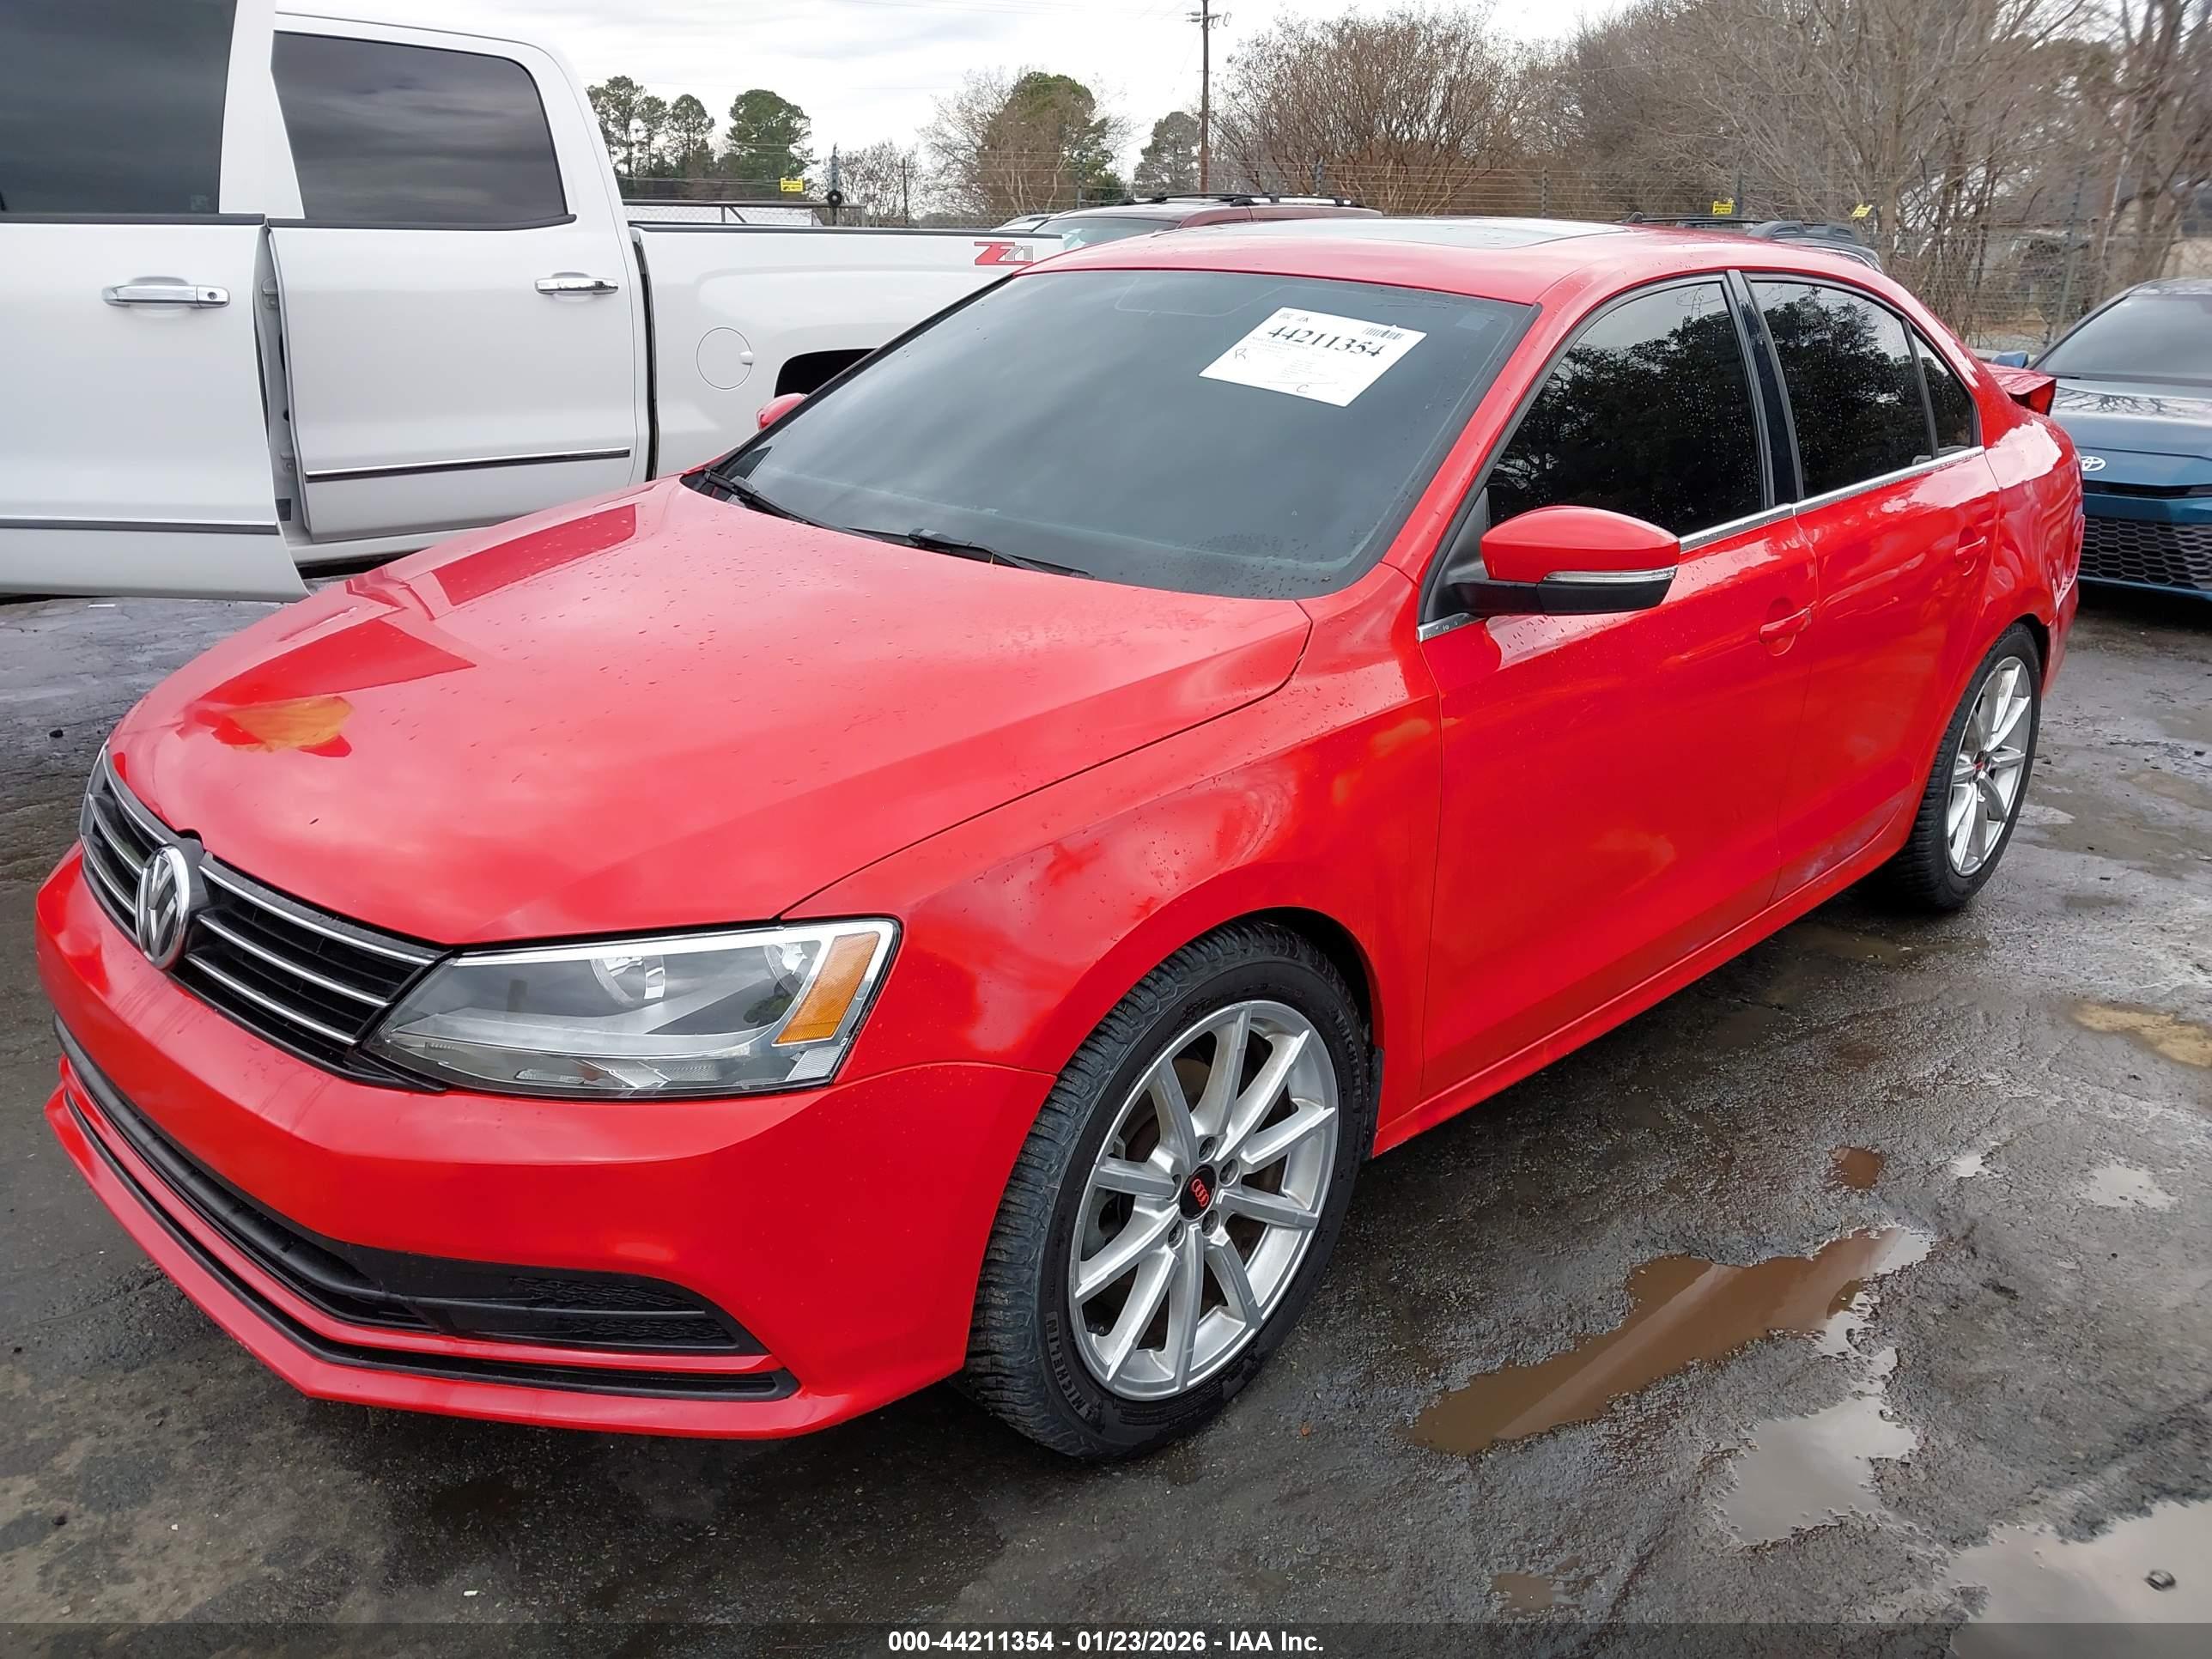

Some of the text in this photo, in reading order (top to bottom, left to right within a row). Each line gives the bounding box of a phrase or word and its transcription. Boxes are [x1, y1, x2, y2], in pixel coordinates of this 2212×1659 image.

[975, 241, 1034, 266] Z71
[1267, 325, 1387, 357] 44211354
[1045, 1317, 1087, 1411] MICHELIN
